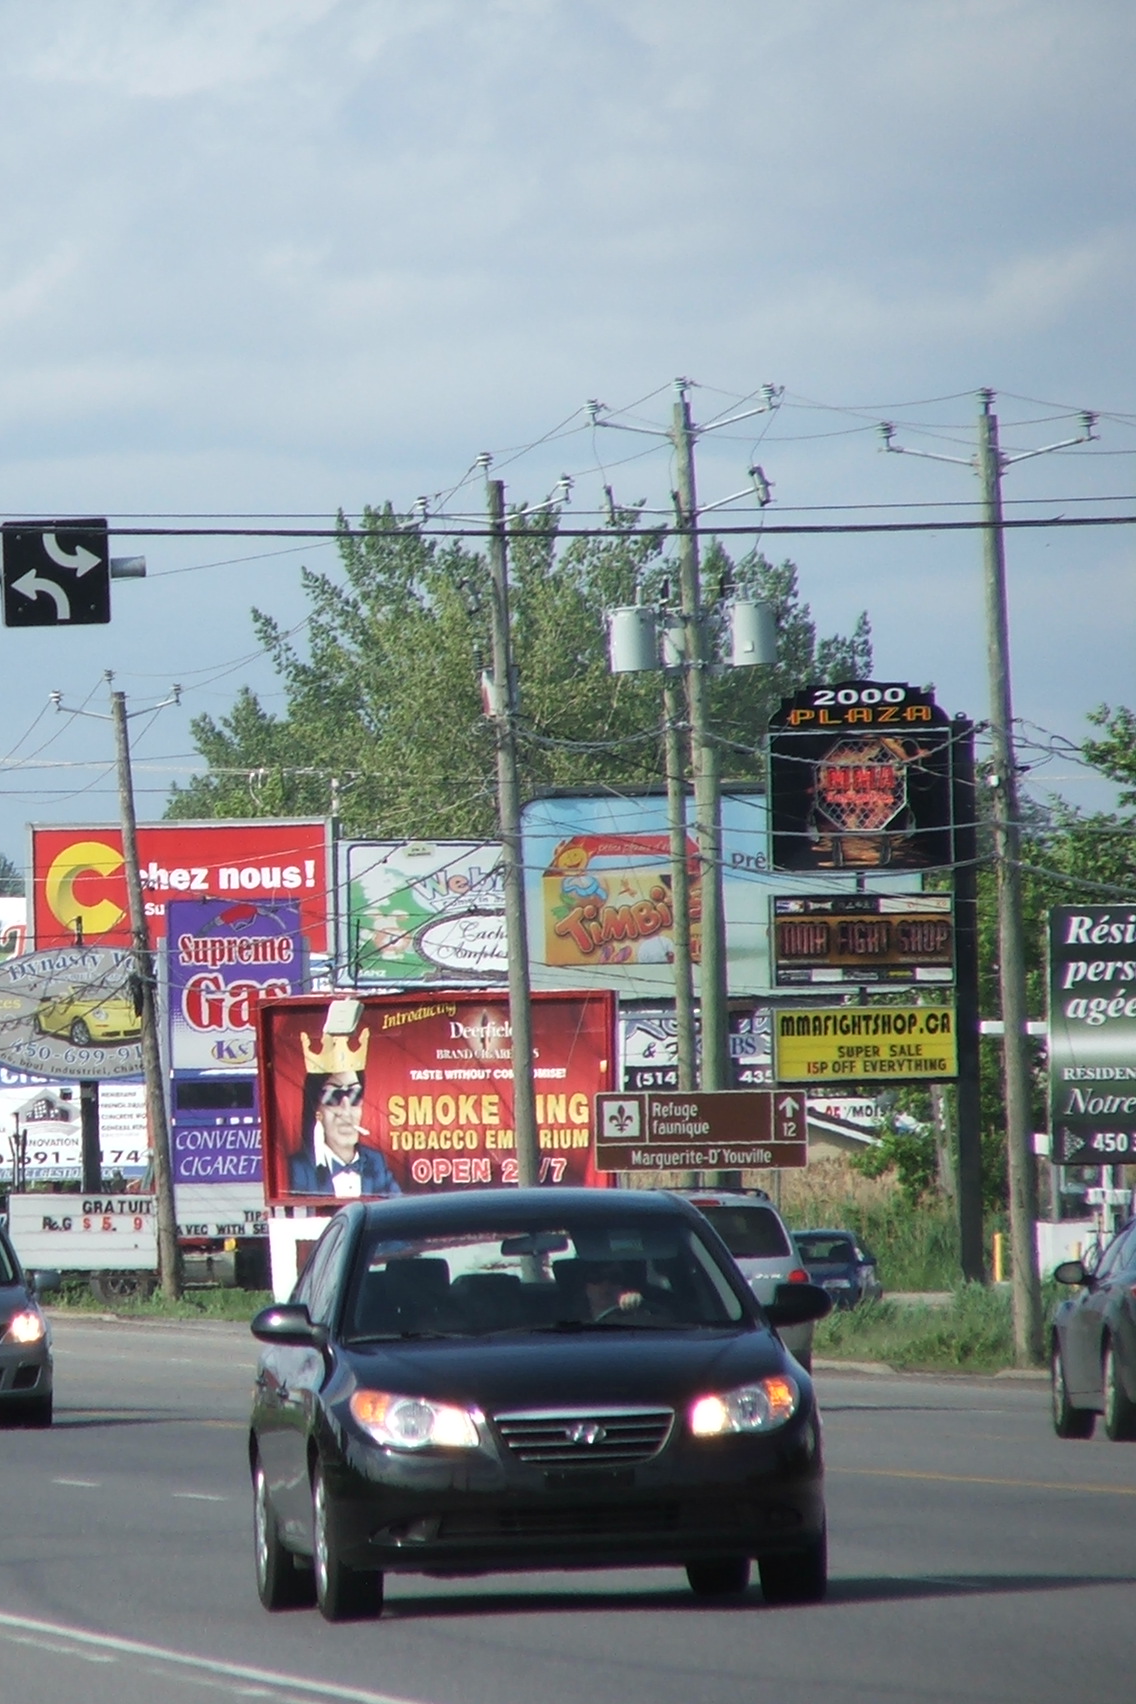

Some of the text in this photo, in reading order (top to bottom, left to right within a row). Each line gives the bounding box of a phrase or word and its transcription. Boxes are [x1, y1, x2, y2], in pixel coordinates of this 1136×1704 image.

[814, 687, 906, 705] 2000
[787, 705, 932, 725] PLAZA
[219, 860, 315, 889] nous!
[897, 920, 951, 953] SHOP
[180, 934, 293, 969] Supreme
[9, 953, 103, 982] Dynasty
[382, 1002, 457, 1029] Introducing
[780, 1013, 951, 1036] MMAFIGHTSHOP.CA
[436, 1049, 473, 1060] BRAND
[837, 1045, 923, 1059] SUPER SALE
[410, 1069, 443, 1081] TASTE
[444, 1068, 491, 1080] WITHOUT
[831, 1060, 857, 1073] OFF
[863, 1057, 947, 1073] EVERYTHING
[388, 1092, 590, 1126] SMOKE ING
[1063, 1087, 1136, 1115] Notre
[652, 1102, 698, 1121] Refuge
[652, 1120, 710, 1137] faunique
[782, 1121, 797, 1137] 12
[390, 1128, 589, 1150] TOBACCO EMRIUM
[1093, 1132, 1129, 1152] 450
[411, 1157, 568, 1183] OPEN 2/7
[82, 1200, 152, 1214] GRATUIT
[216, 1224, 246, 1235] WITH
